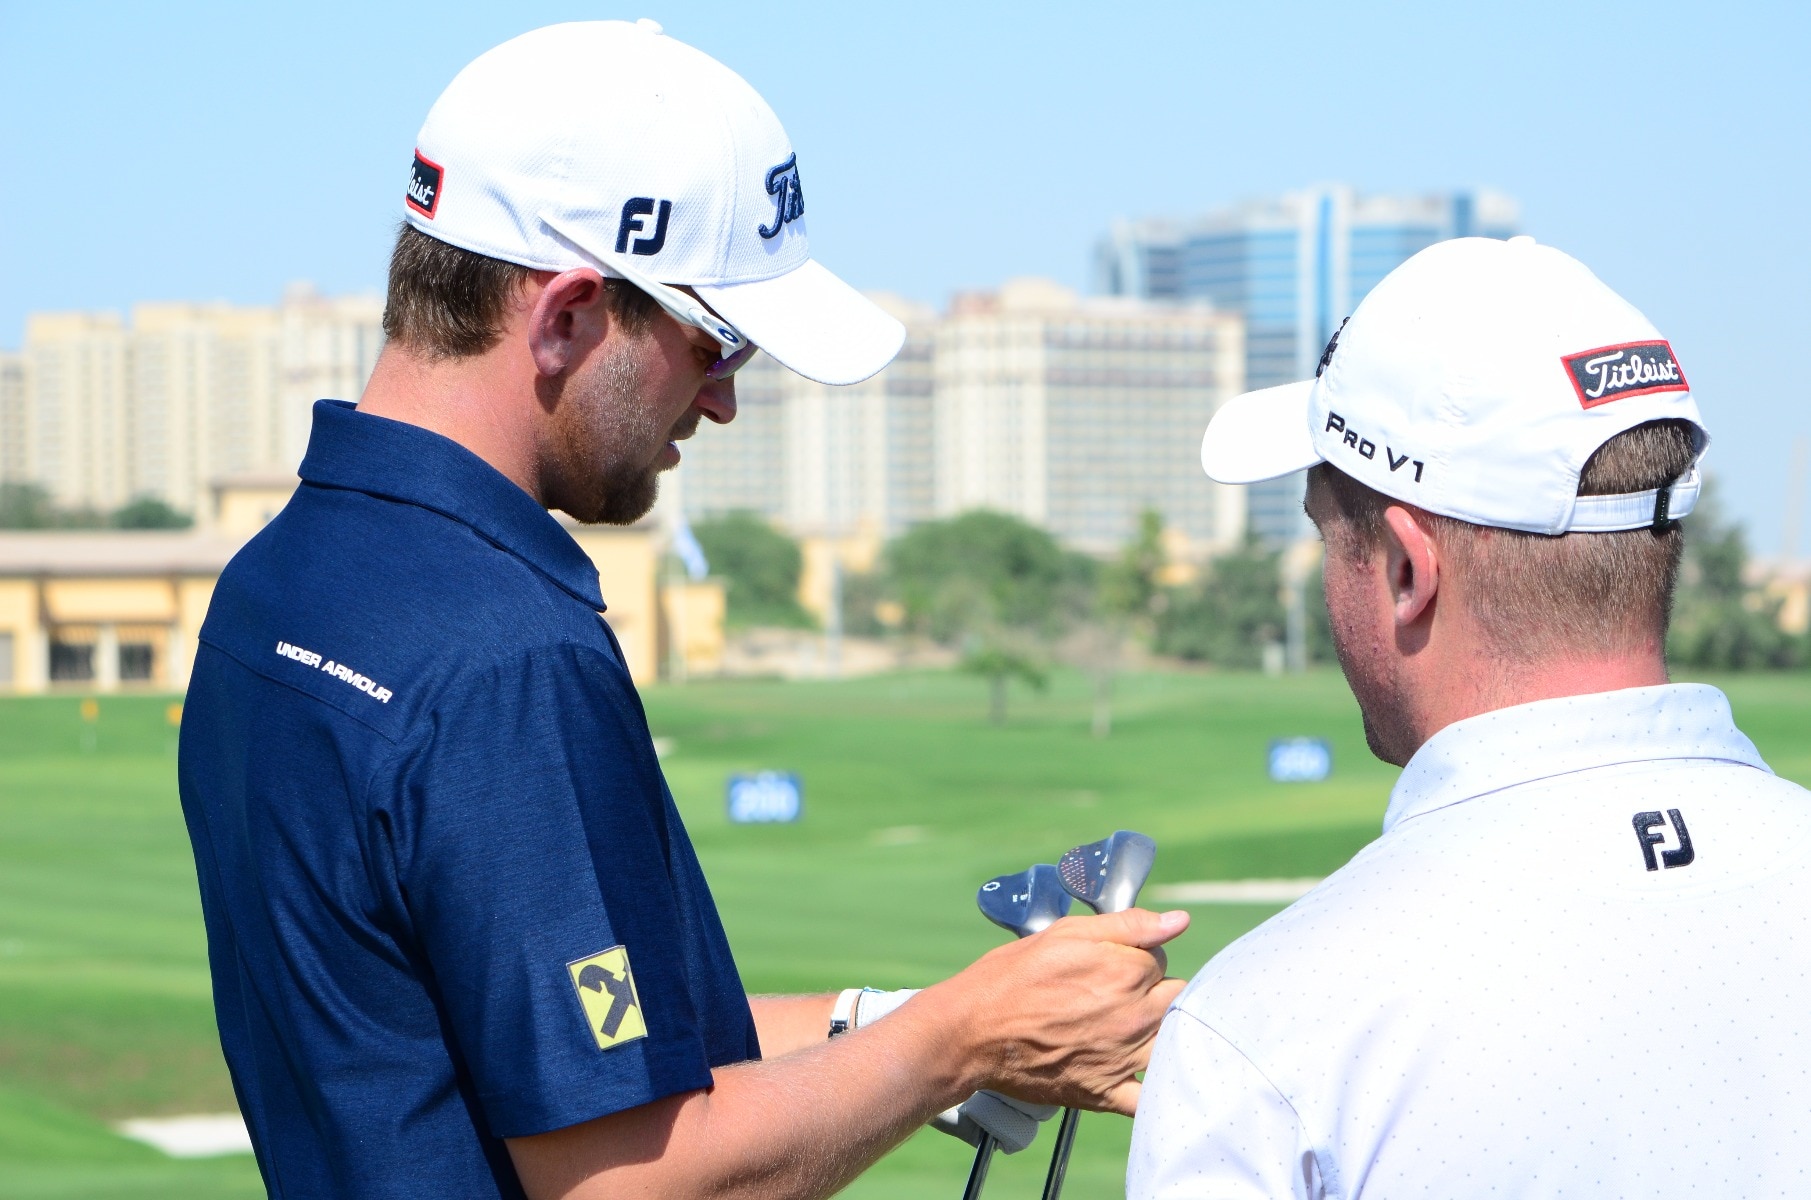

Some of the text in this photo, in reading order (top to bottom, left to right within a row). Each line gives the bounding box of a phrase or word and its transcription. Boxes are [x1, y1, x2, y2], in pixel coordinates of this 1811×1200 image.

[615, 197, 672, 256] FJ
[1585, 351, 1679, 398] Titleist
[1386, 446, 1425, 483] V1
[276, 641, 393, 704] UNDER ARMOUR
[1631, 808, 1695, 872] FJ
